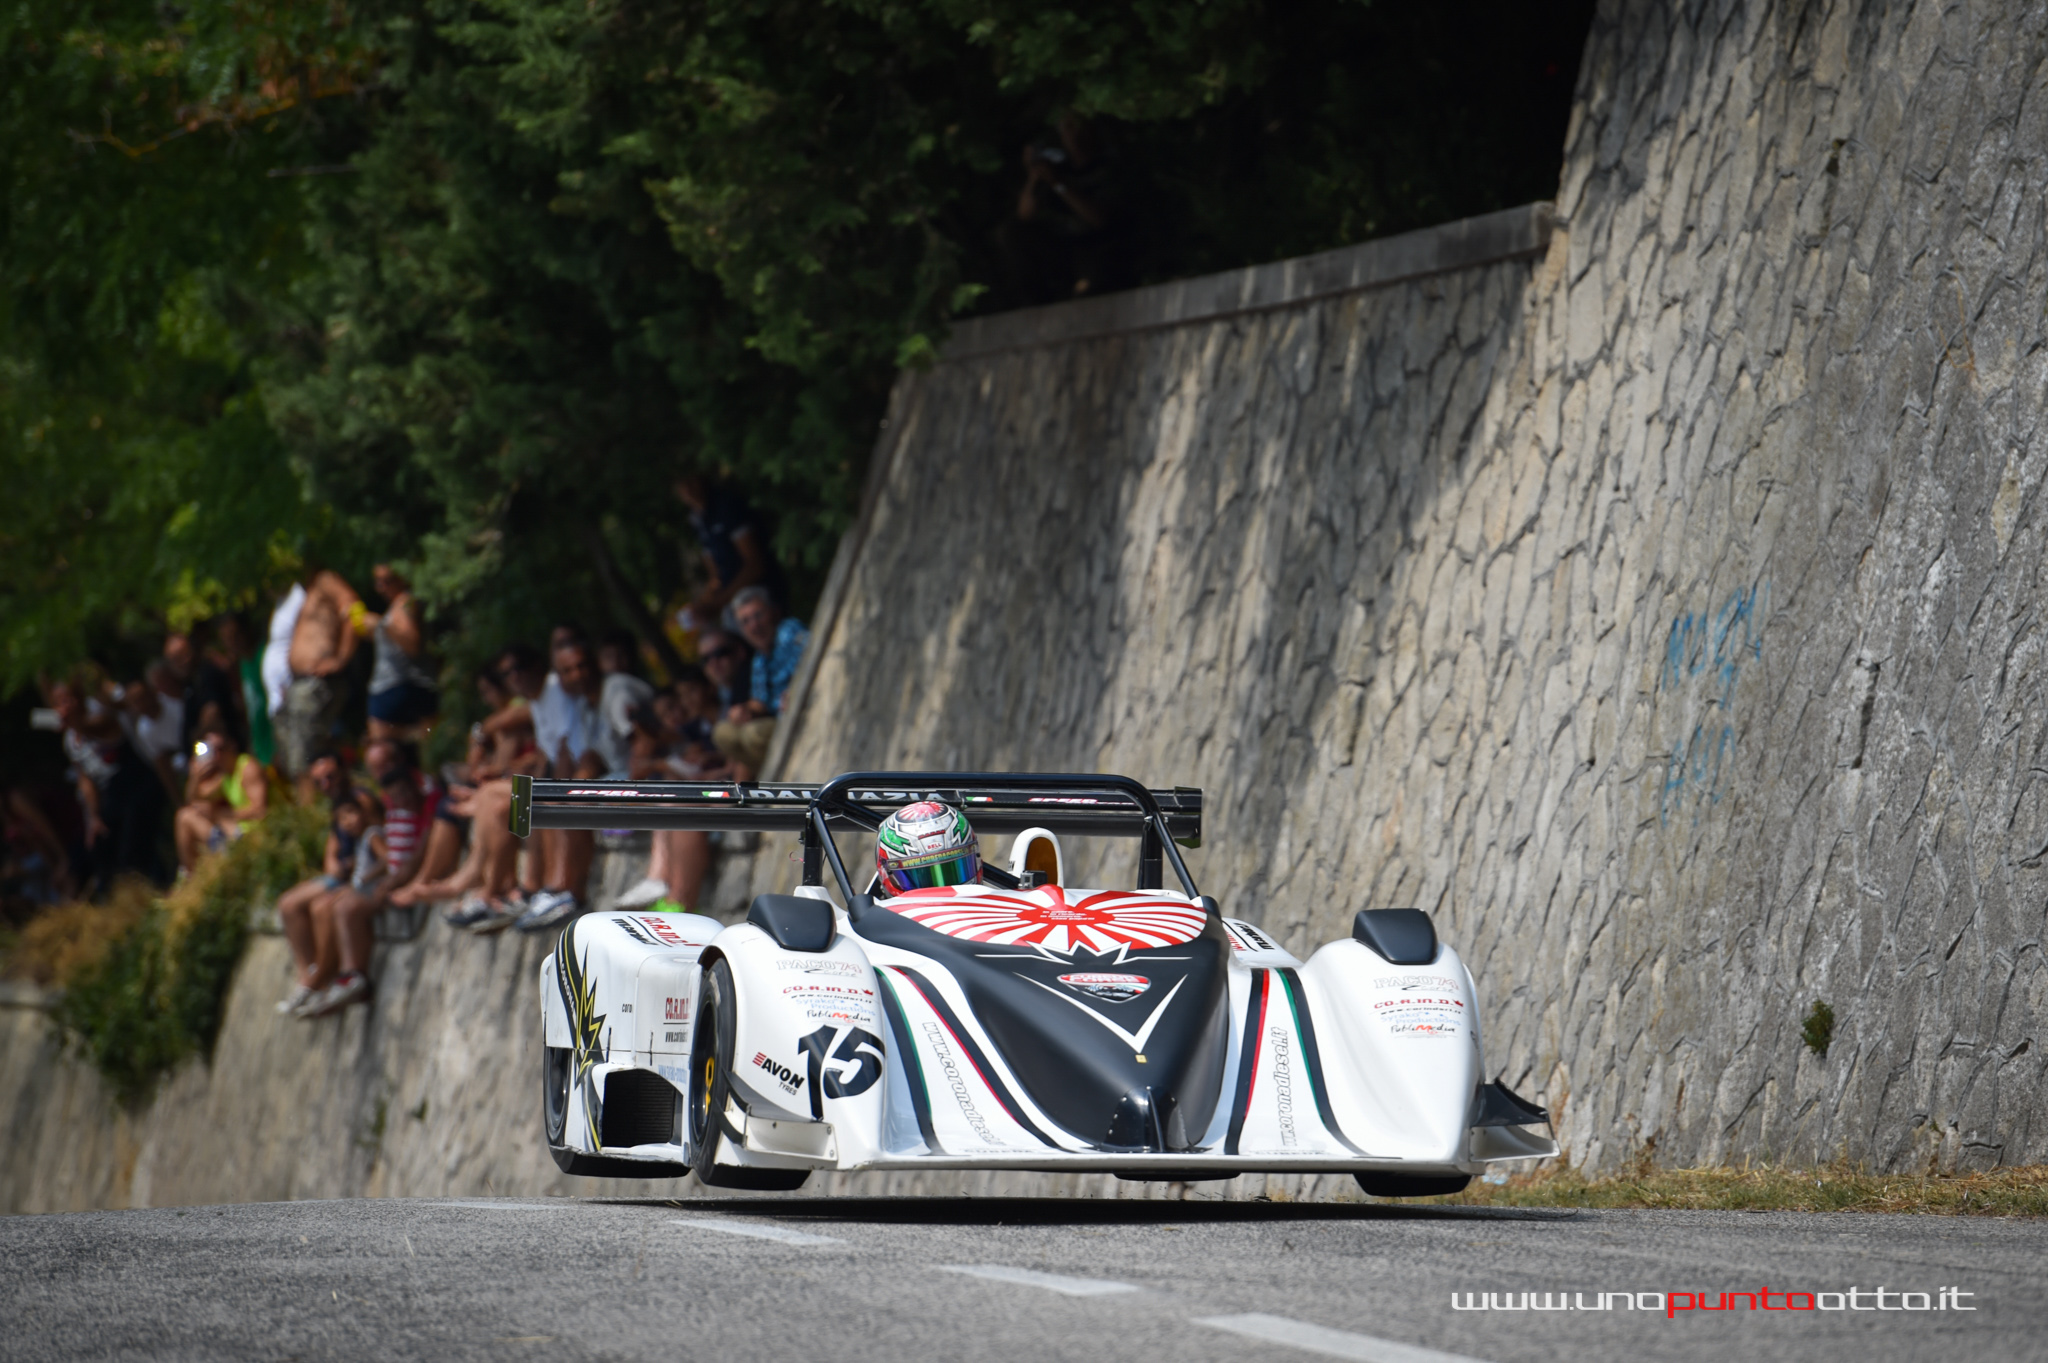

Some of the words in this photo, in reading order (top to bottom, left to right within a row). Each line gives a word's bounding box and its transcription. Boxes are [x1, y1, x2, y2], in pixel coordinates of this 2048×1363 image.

[927, 842, 942, 850] BELL
[797, 1024, 886, 1120] 15
[778, 1082, 798, 1096] TYRES
